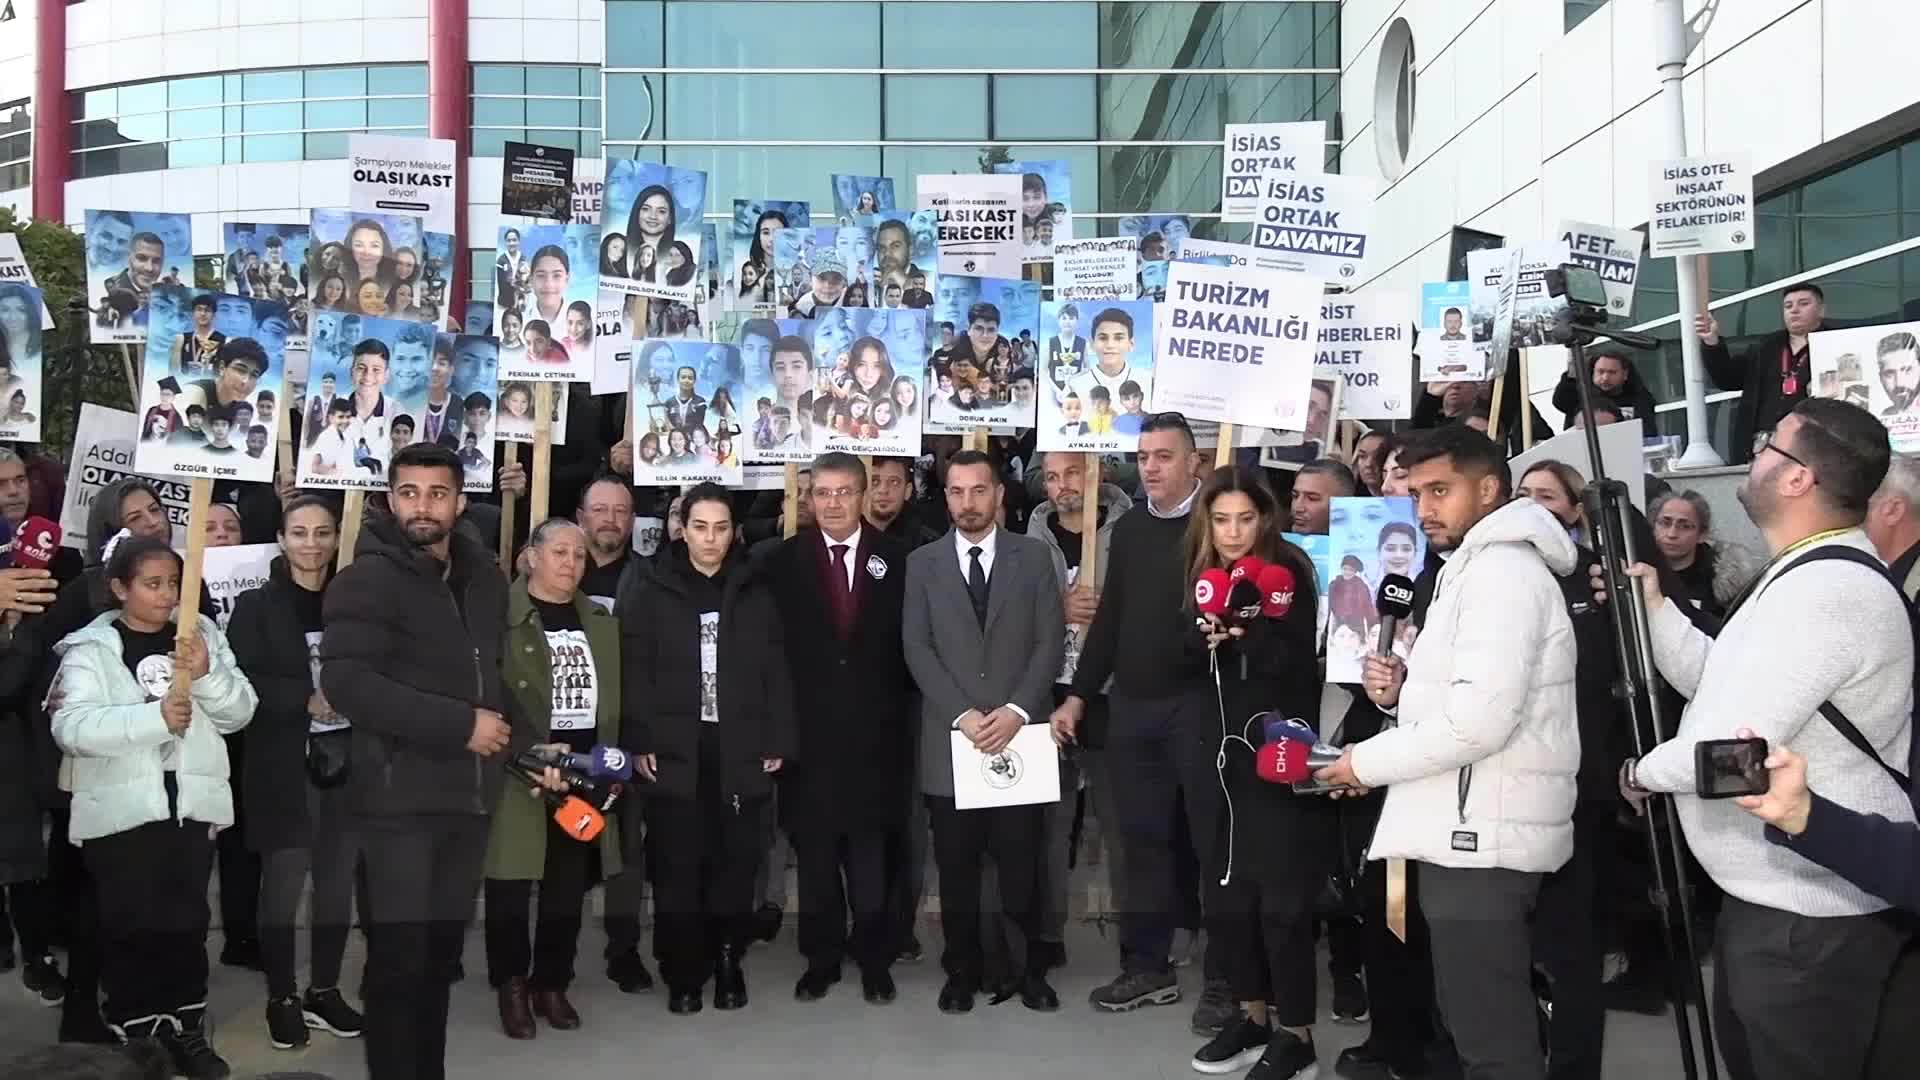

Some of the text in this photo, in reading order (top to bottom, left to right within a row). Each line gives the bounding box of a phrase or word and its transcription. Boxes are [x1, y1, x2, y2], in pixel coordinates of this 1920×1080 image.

[1232, 133, 1281, 152] İSİAS
[355, 157, 452, 171] Şampiyon Melekler
[1231, 156, 1296, 173] ORTAK
[1664, 163, 1734, 180] İSİAS OTEL
[354, 170, 453, 188] OLASI KAST
[1675, 180, 1723, 195] İNŞAAT
[570, 182, 604, 196] AMP
[1267, 178, 1325, 203] İSİAS
[572, 199, 601, 212] ELE
[1656, 193, 1745, 213] SEKTÖRÜNÜN
[936, 209, 1017, 222] LASI KAST
[1264, 205, 1340, 229] ORTAK
[1656, 210, 1745, 229] FELAKETİDİR!
[937, 225, 1014, 241] ERECEK!
[1259, 227, 1362, 256] DAVAMIZ
[1561, 232, 1615, 255] AFET
[1177, 280, 1270, 309] TURİZM
[596, 322, 622, 336] LA
[1172, 308, 1309, 341] BAKANLIĞI
[1168, 337, 1265, 365] NEREDE
[1313, 350, 1362, 365] ALET
[88, 444, 136, 466] Adal
[233, 576, 269, 589] Mele
